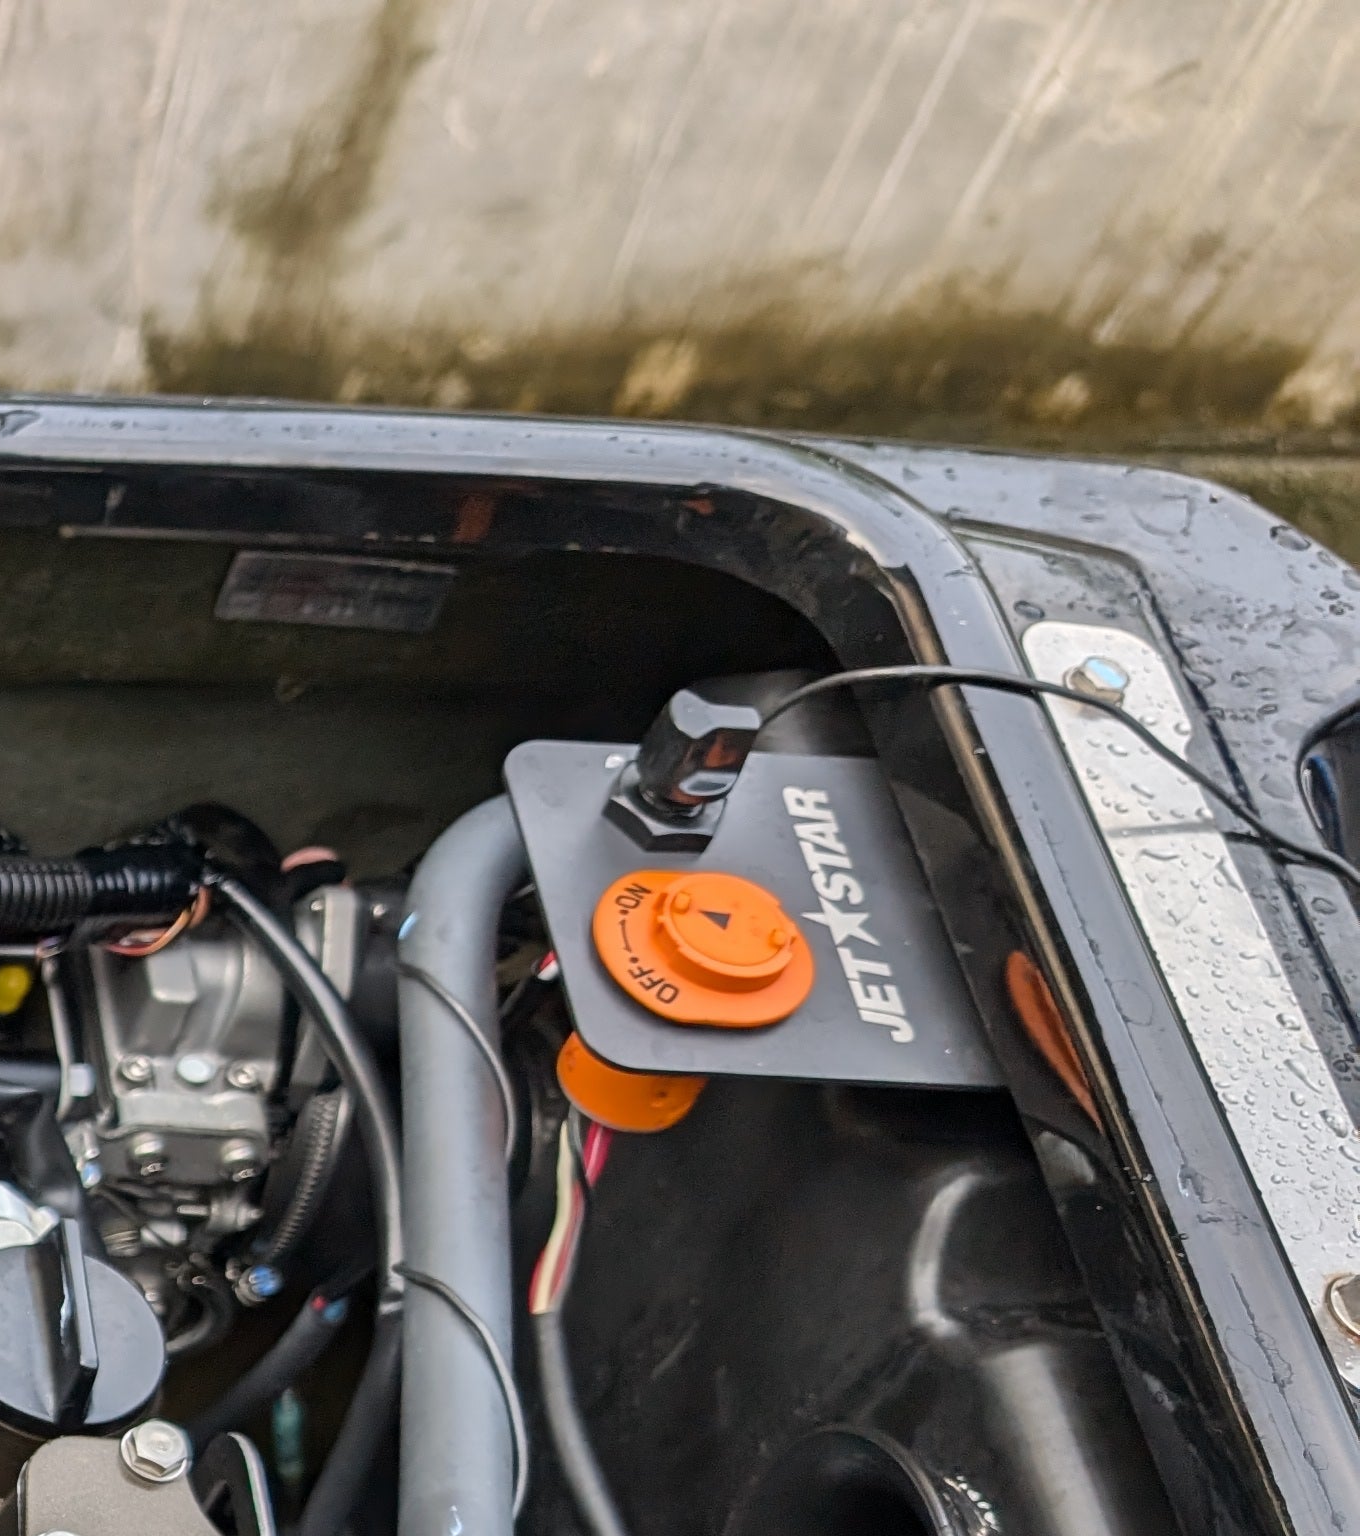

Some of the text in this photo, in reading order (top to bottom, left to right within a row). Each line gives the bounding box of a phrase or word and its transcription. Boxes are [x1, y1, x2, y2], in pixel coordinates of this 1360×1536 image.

[615, 883, 652, 909] ON
[782, 786, 915, 1043] JET STAR
[627, 966, 680, 1004] OFF
